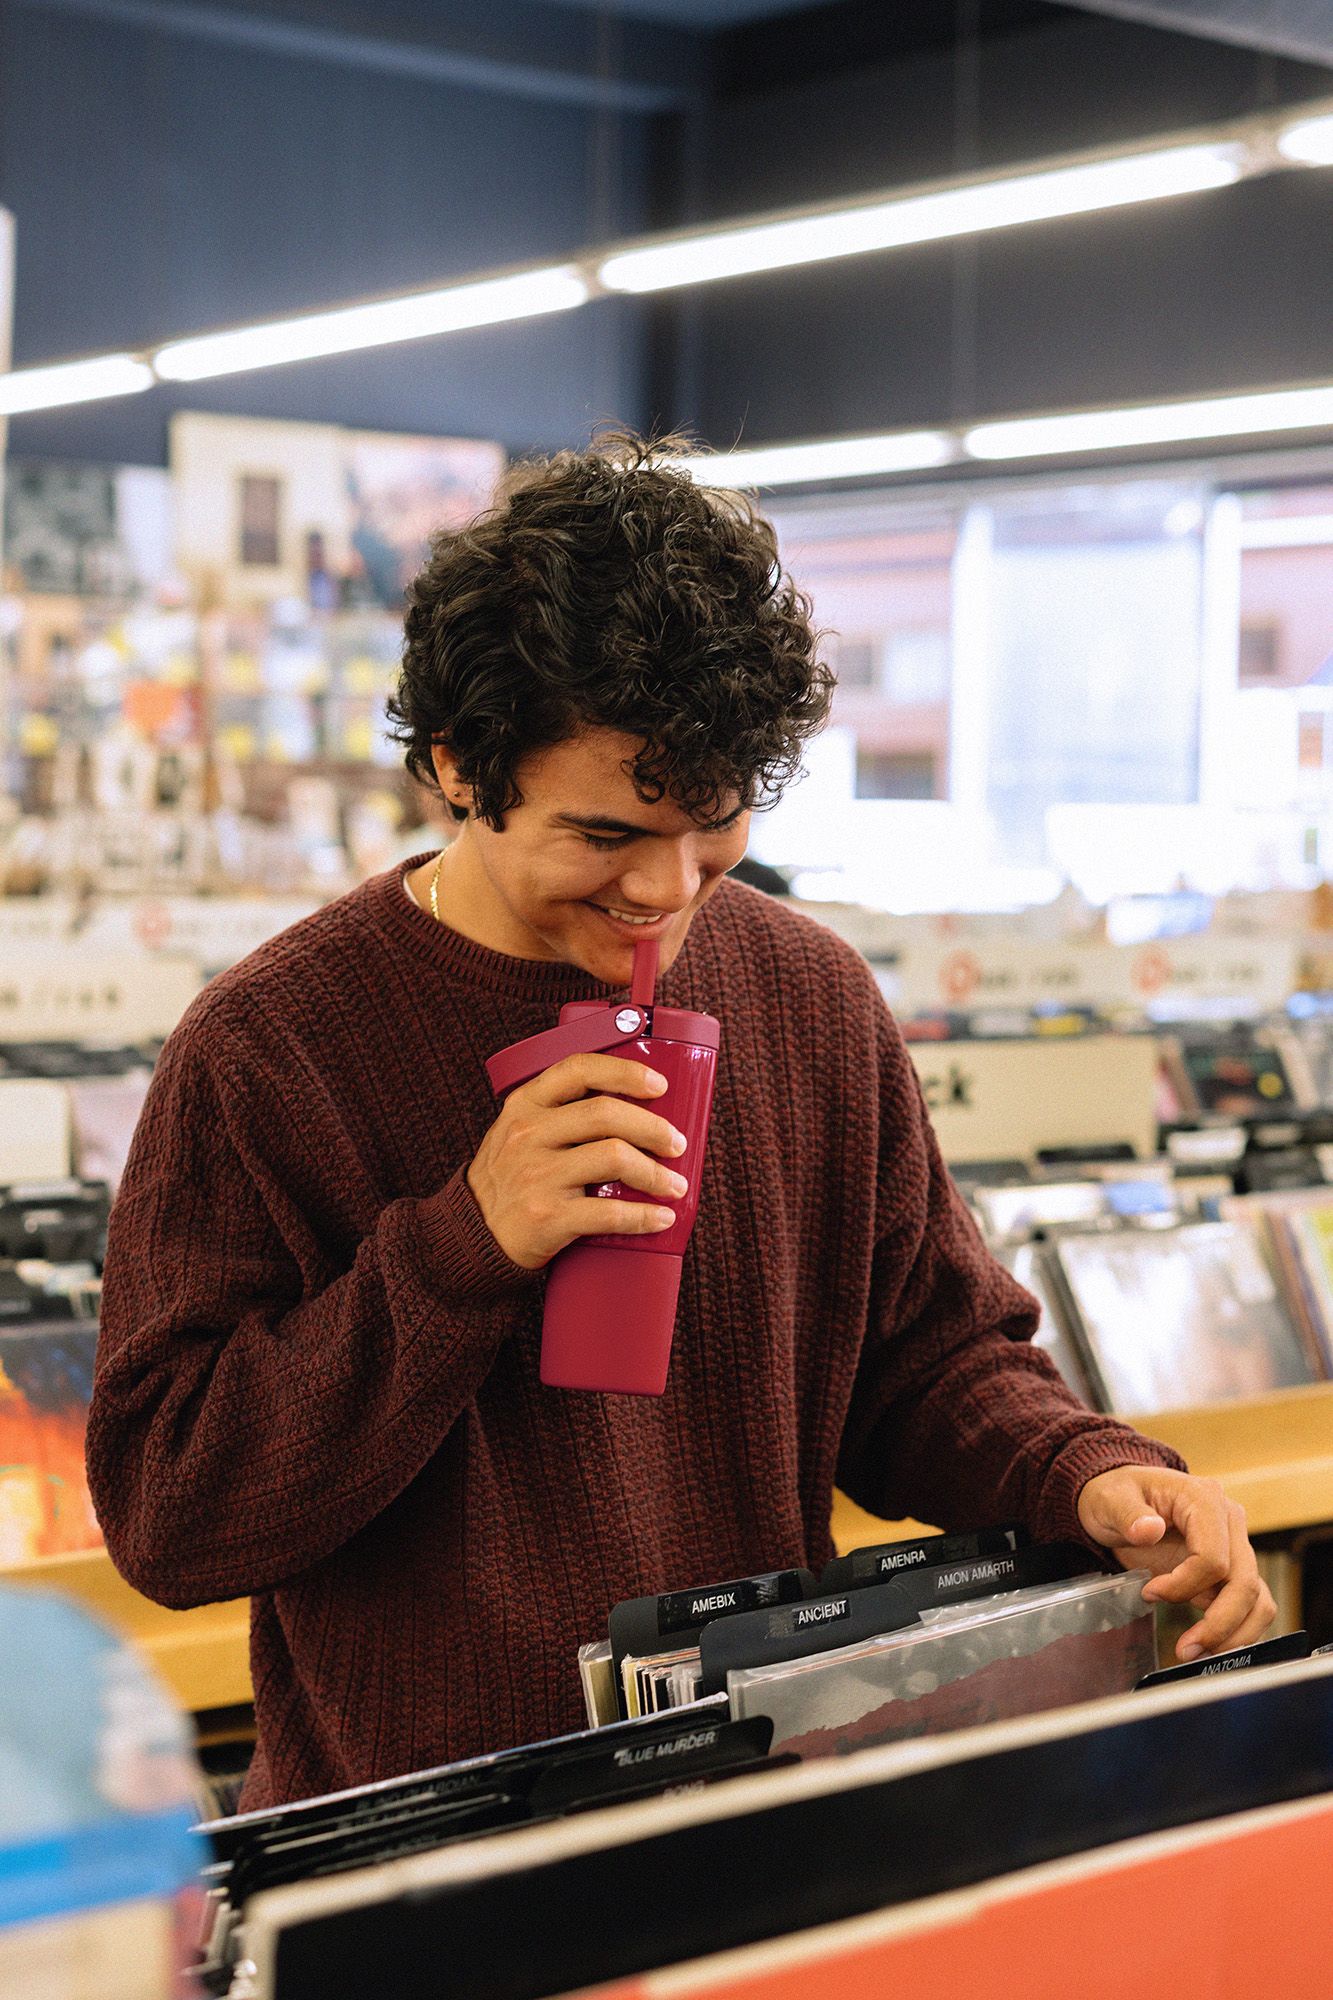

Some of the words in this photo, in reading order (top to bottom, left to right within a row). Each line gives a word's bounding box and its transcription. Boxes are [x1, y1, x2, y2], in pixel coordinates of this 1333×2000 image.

[880, 1549, 927, 1572] AMENRA
[937, 1571, 970, 1589] AMON
[971, 1559, 1016, 1580] AMARTH
[691, 1592, 737, 1614] AMEBIX
[797, 1599, 848, 1625] ANCIENT
[1200, 1654, 1253, 1677] ANATOMIA
[616, 1746, 656, 1767] BLUE
[656, 1730, 716, 1757] MURDER
